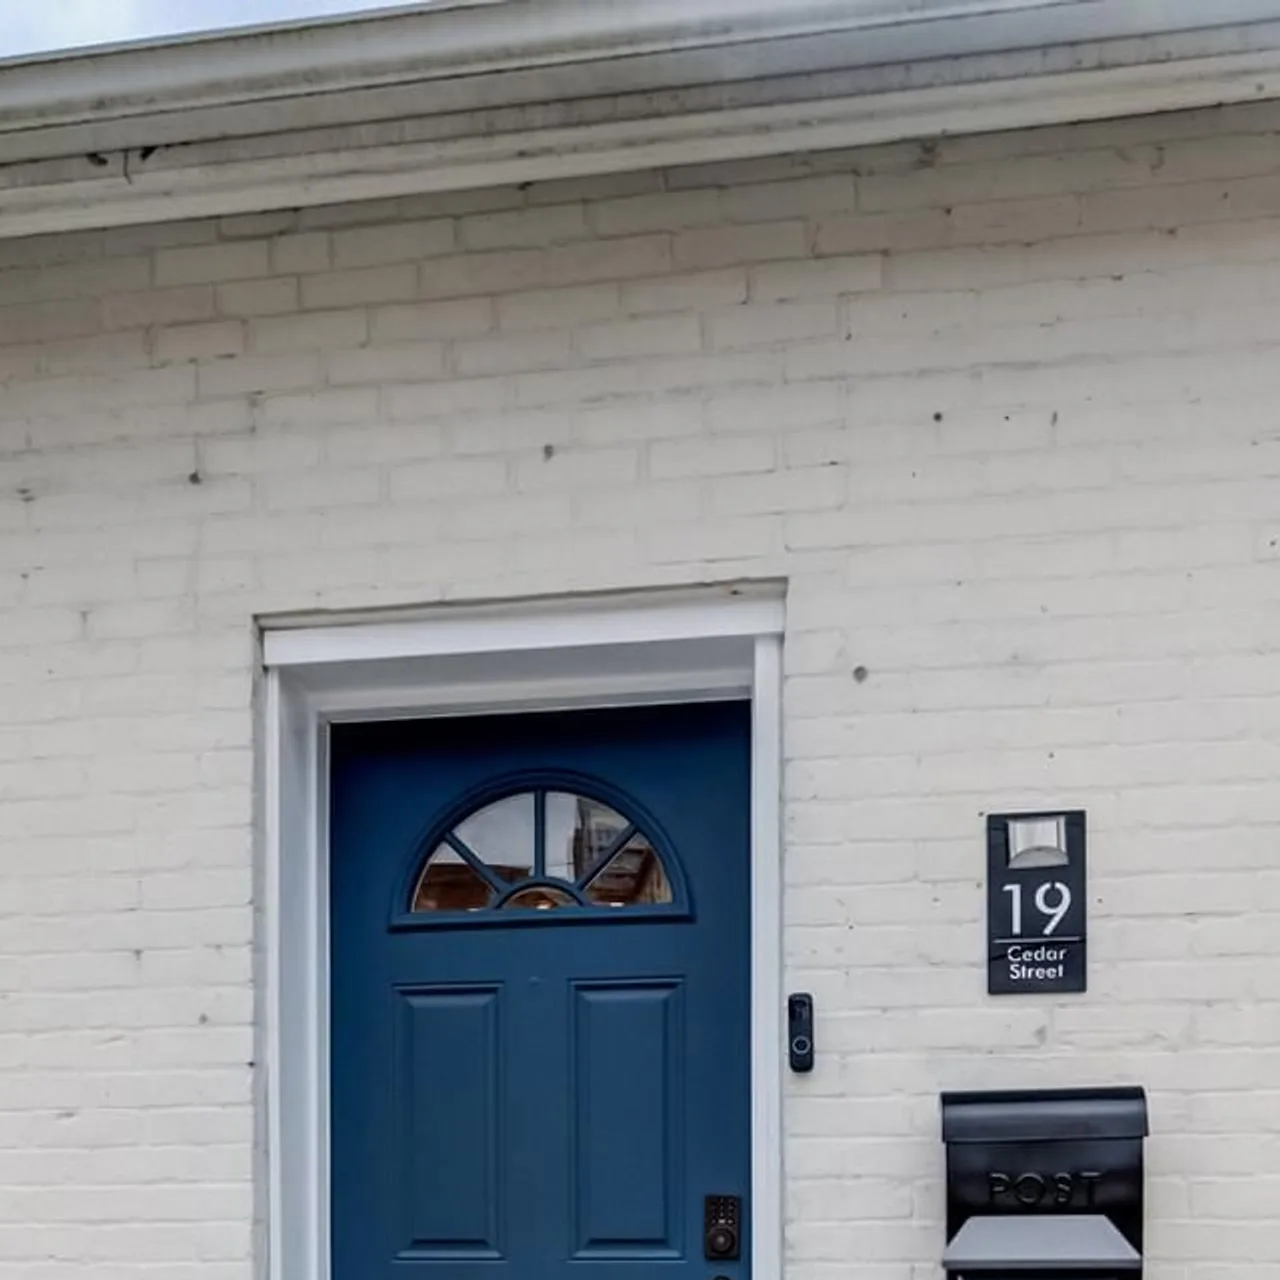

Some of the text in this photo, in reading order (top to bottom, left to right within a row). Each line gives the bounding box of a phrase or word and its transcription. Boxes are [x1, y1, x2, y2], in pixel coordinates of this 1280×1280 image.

[1002, 881, 1072, 936] 19
[1007, 945, 1067, 962] Cedar
[1009, 963, 1064, 980] Street
[990, 1171, 1102, 1205] POST
